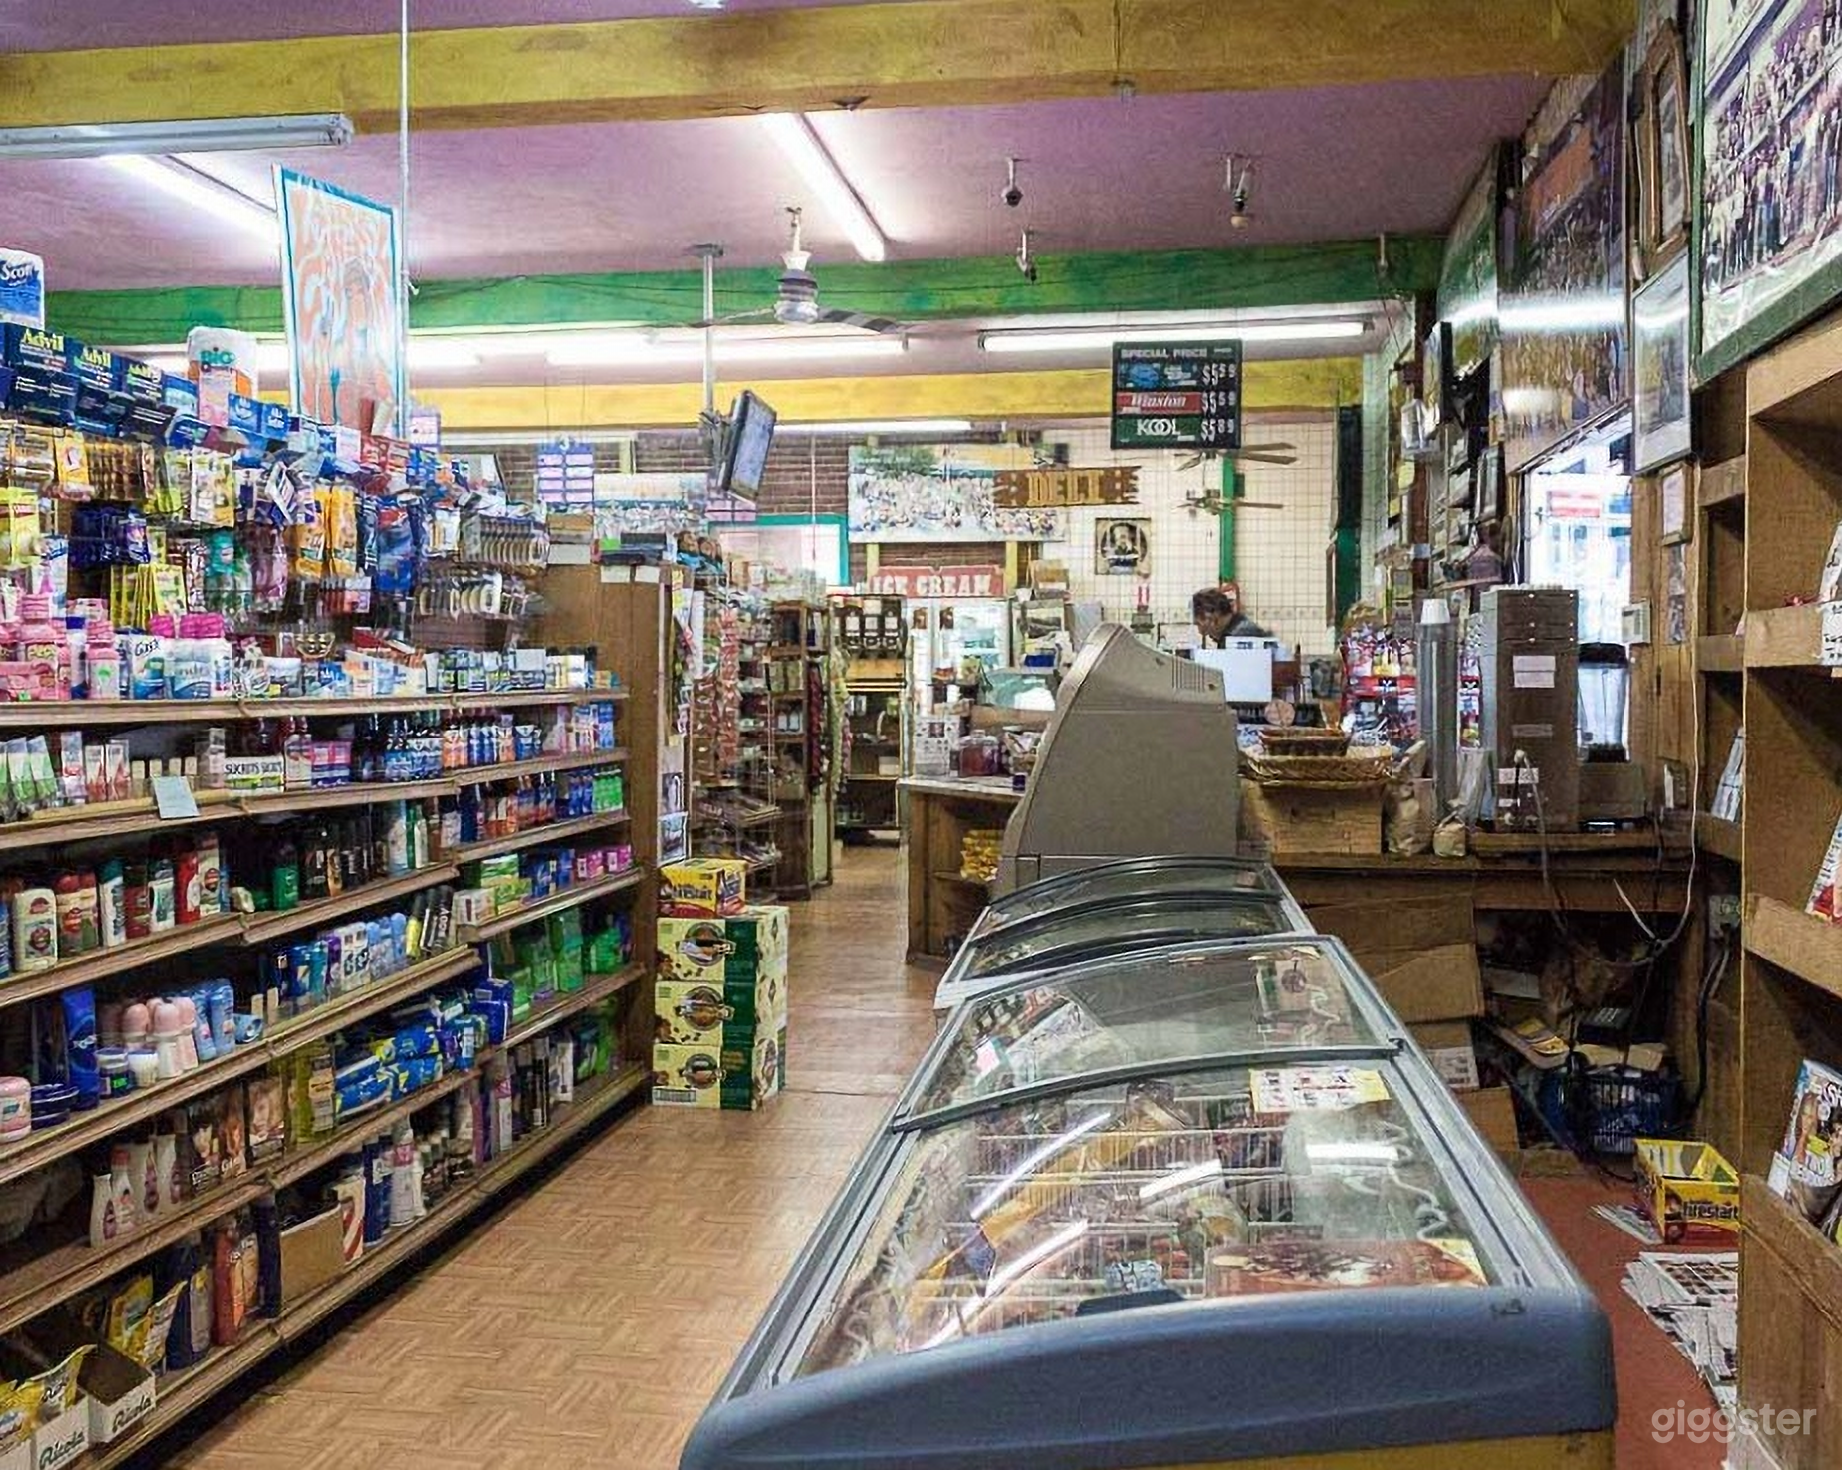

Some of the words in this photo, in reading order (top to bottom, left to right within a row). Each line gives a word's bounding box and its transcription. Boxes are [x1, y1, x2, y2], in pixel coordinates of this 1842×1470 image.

[21, 328, 65, 353] Advil
[1131, 391, 1187, 408] Winston
[1136, 418, 1181, 436] KOOL
[1027, 470, 1102, 506] DELI
[873, 575, 908, 595] ICE
[916, 574, 992, 597] CREAM
